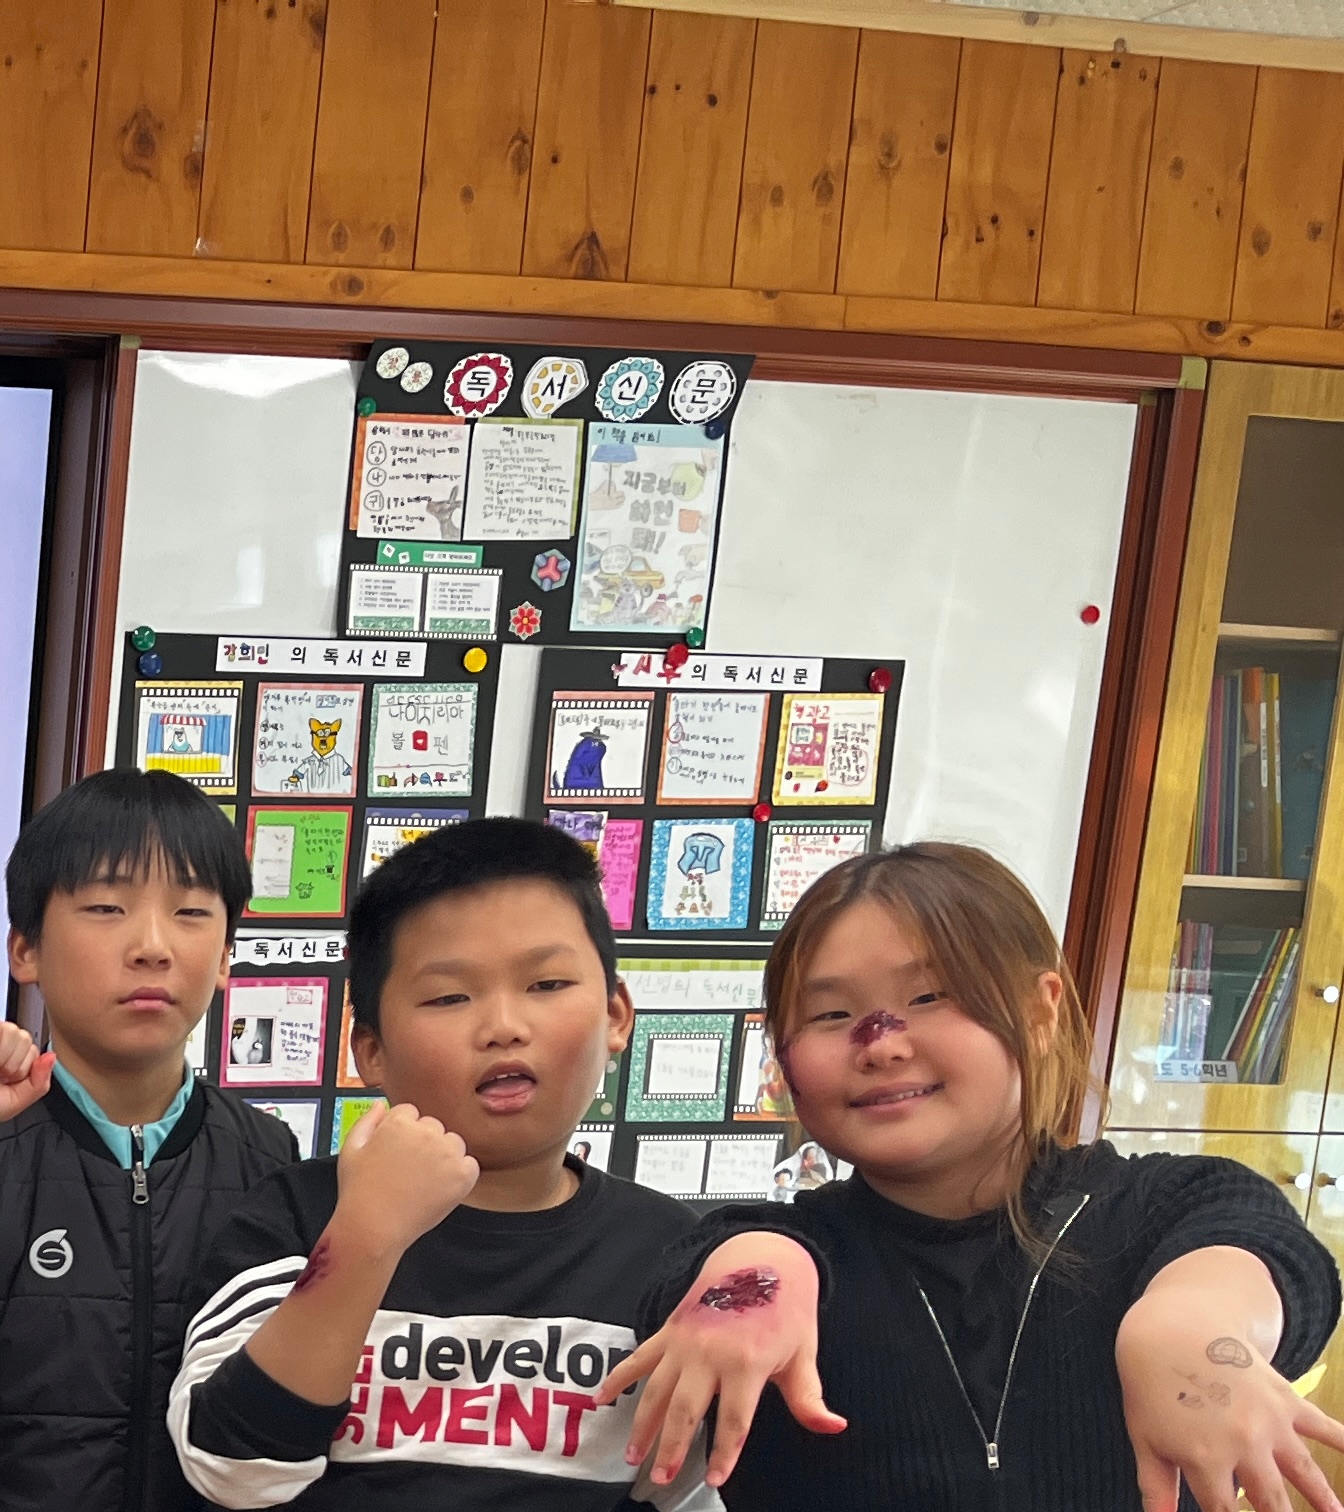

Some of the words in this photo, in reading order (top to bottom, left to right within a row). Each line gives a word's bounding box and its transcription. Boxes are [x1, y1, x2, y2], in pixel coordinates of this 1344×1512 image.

[290, 646, 307, 664] 의
[323, 648, 412, 668] 독서신문
[691, 664, 707, 681] 의
[723, 665, 808, 685] 독서신문
[254, 941, 341, 958] 독서신문
[376, 1383, 597, 1457] MENT
